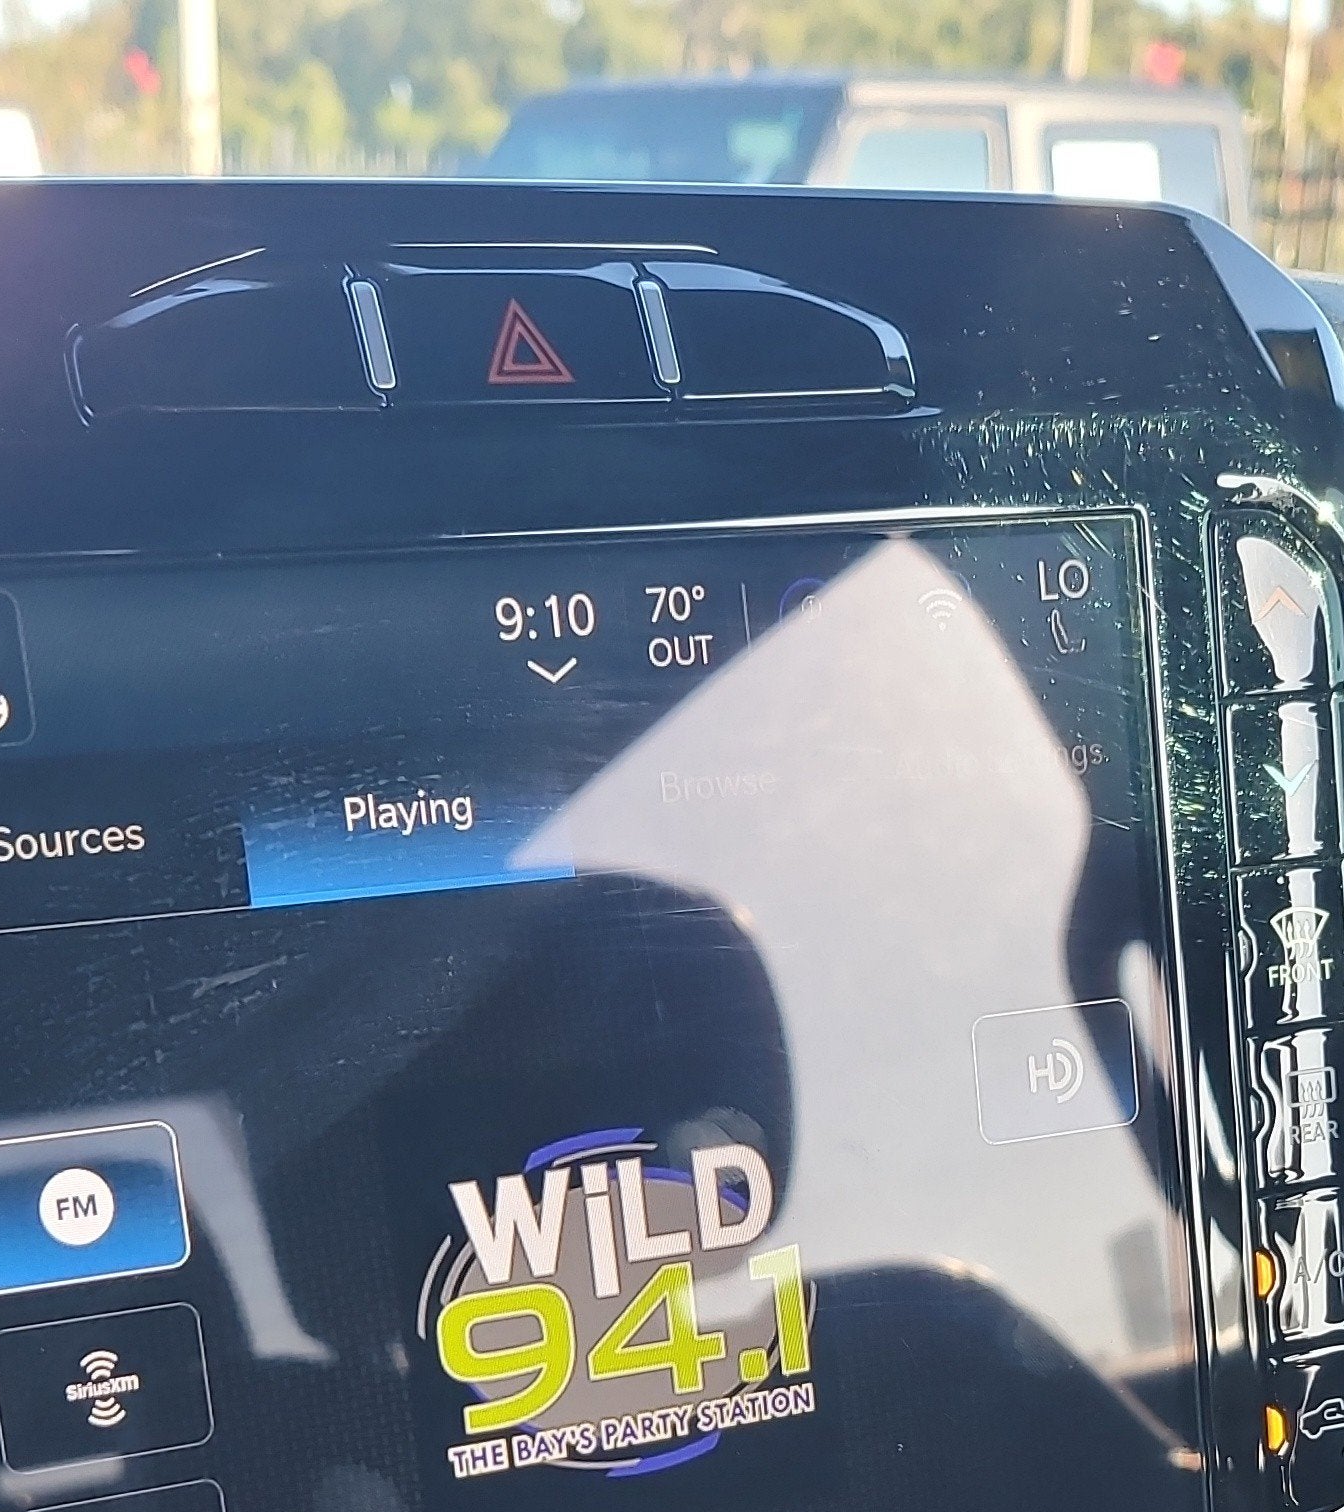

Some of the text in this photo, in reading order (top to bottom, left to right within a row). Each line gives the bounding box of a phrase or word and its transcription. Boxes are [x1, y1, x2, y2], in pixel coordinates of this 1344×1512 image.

[1037, 559, 1090, 601] LO
[493, 592, 595, 641] 9:10
[645, 584, 706, 624] 70°
[647, 633, 715, 668] OUT
[659, 769, 777, 803] Browse
[343, 791, 474, 836] Playing
[1268, 959, 1334, 988] FRONT
[1289, 1120, 1340, 1146] REAR
[56, 1194, 99, 1220] FM
[436, 1244, 810, 1435] 94.1
[448, 1383, 816, 1478] THE BAY'S PARTY STATION
